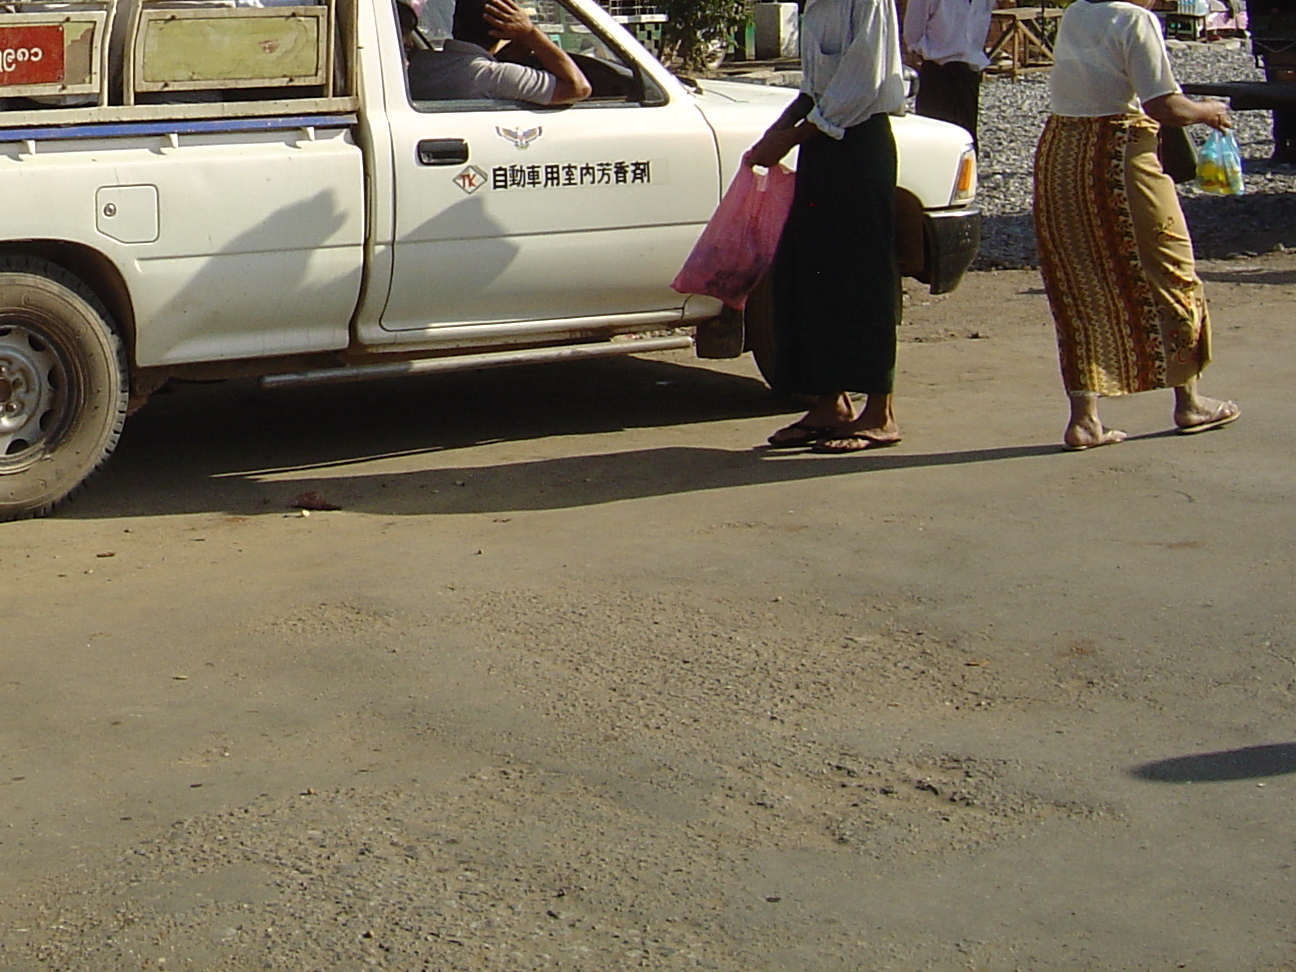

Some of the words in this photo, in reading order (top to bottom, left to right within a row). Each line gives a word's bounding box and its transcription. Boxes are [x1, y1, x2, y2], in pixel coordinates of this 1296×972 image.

[492, 160, 651, 190] 自動車用室内芳香剤
